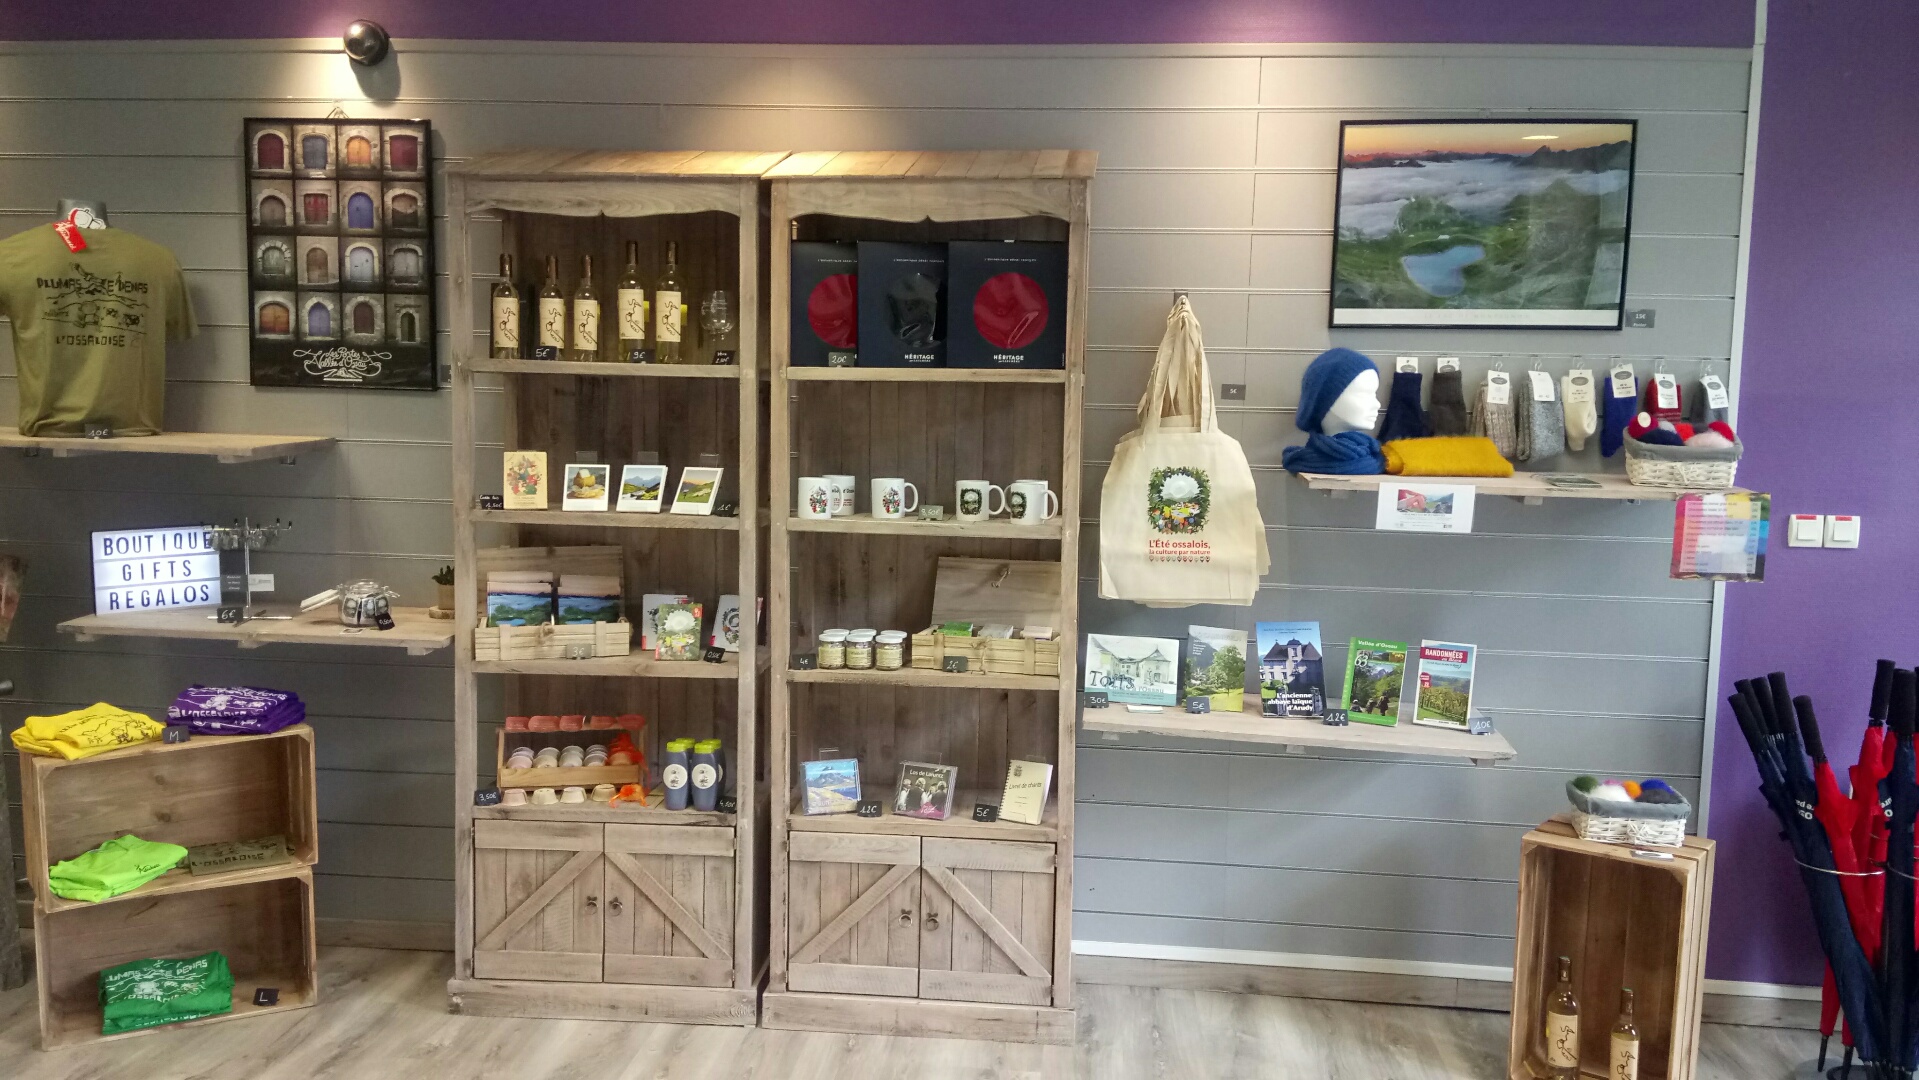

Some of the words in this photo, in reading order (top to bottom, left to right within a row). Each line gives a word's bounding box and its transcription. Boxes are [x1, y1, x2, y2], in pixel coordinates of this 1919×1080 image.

[535, 348, 550, 358] 5€
[633, 351, 645, 359] 9€
[993, 353, 1024, 361] HÉRITAGE
[831, 354, 847, 365] 20€
[88, 428, 108, 437] 10€
[103, 531, 212, 556] BOUTIQUE
[1149, 538, 1170, 548] L'Été
[1172, 540, 1211, 549] ossalois,
[122, 559, 192, 582] GIFTS
[109, 584, 209, 611] REGALOS
[221, 609, 236, 620] 6€
[1424, 648, 1463, 659] RANDONNÉES
[799, 657, 808, 665] 4€
[946, 660, 958, 669] 2€
[1089, 696, 1107, 704] 30€
[1292, 698, 1313, 706] laïque
[1192, 701, 1205, 710] 5€
[1286, 704, 1313, 712] d'Arudy
[1326, 712, 1346, 722] 12€
[1474, 720, 1491, 730] 10€
[169, 730, 180, 741] M
[479, 793, 497, 802] 3,50€
[976, 807, 990, 817] 5€
[259, 991, 269, 1002] L
